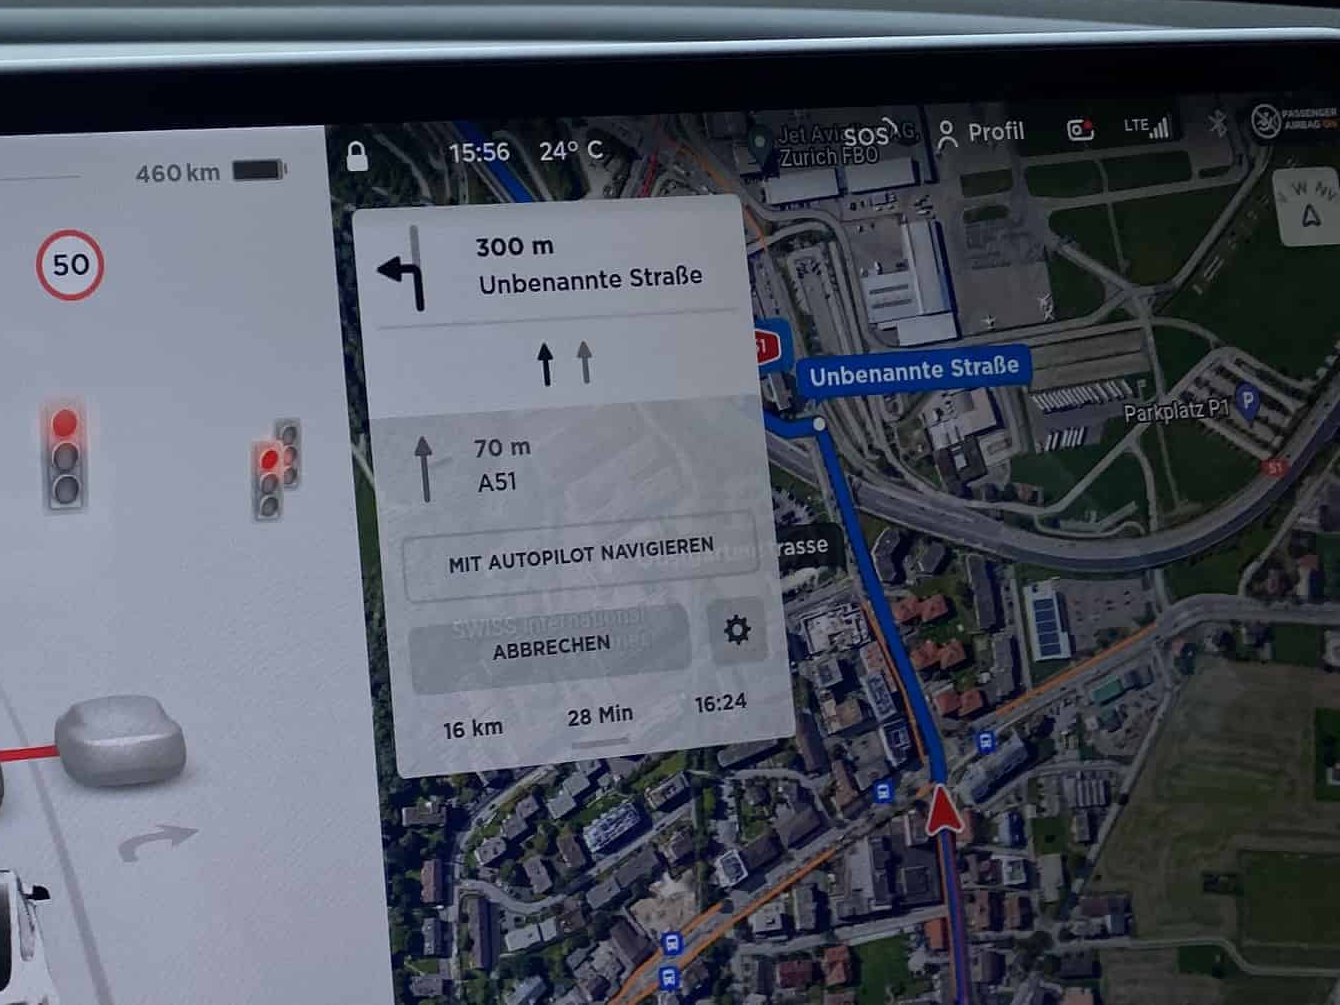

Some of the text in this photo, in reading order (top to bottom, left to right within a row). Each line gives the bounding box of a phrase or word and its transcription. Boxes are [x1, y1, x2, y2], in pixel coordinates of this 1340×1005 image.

[968, 121, 1025, 141] Profil
[1124, 119, 1150, 131] LTE
[844, 128, 889, 146] SOS
[449, 142, 510, 163] 15:56
[587, 140, 604, 159] C
[779, 146, 878, 167] Zurich FBO
[135, 163, 220, 183] 460 km
[476, 237, 555, 257] 300 m
[53, 252, 90, 276] 50
[479, 265, 703, 295] Unbenannte Straße
[810, 355, 1019, 386] Unbenannte Straße
[1124, 403, 1205, 425] Parkplatz
[474, 439, 532, 458] 70 m
[477, 472, 517, 493] A51
[449, 555, 482, 574] MIT
[487, 546, 595, 571] AUTOPILOT
[600, 536, 714, 561] NAVIGIEREN
[492, 635, 611, 661] ABBRECHEN
[695, 692, 748, 713] 16:24
[567, 704, 634, 726] 28 Min
[444, 719, 504, 739] 16 km
